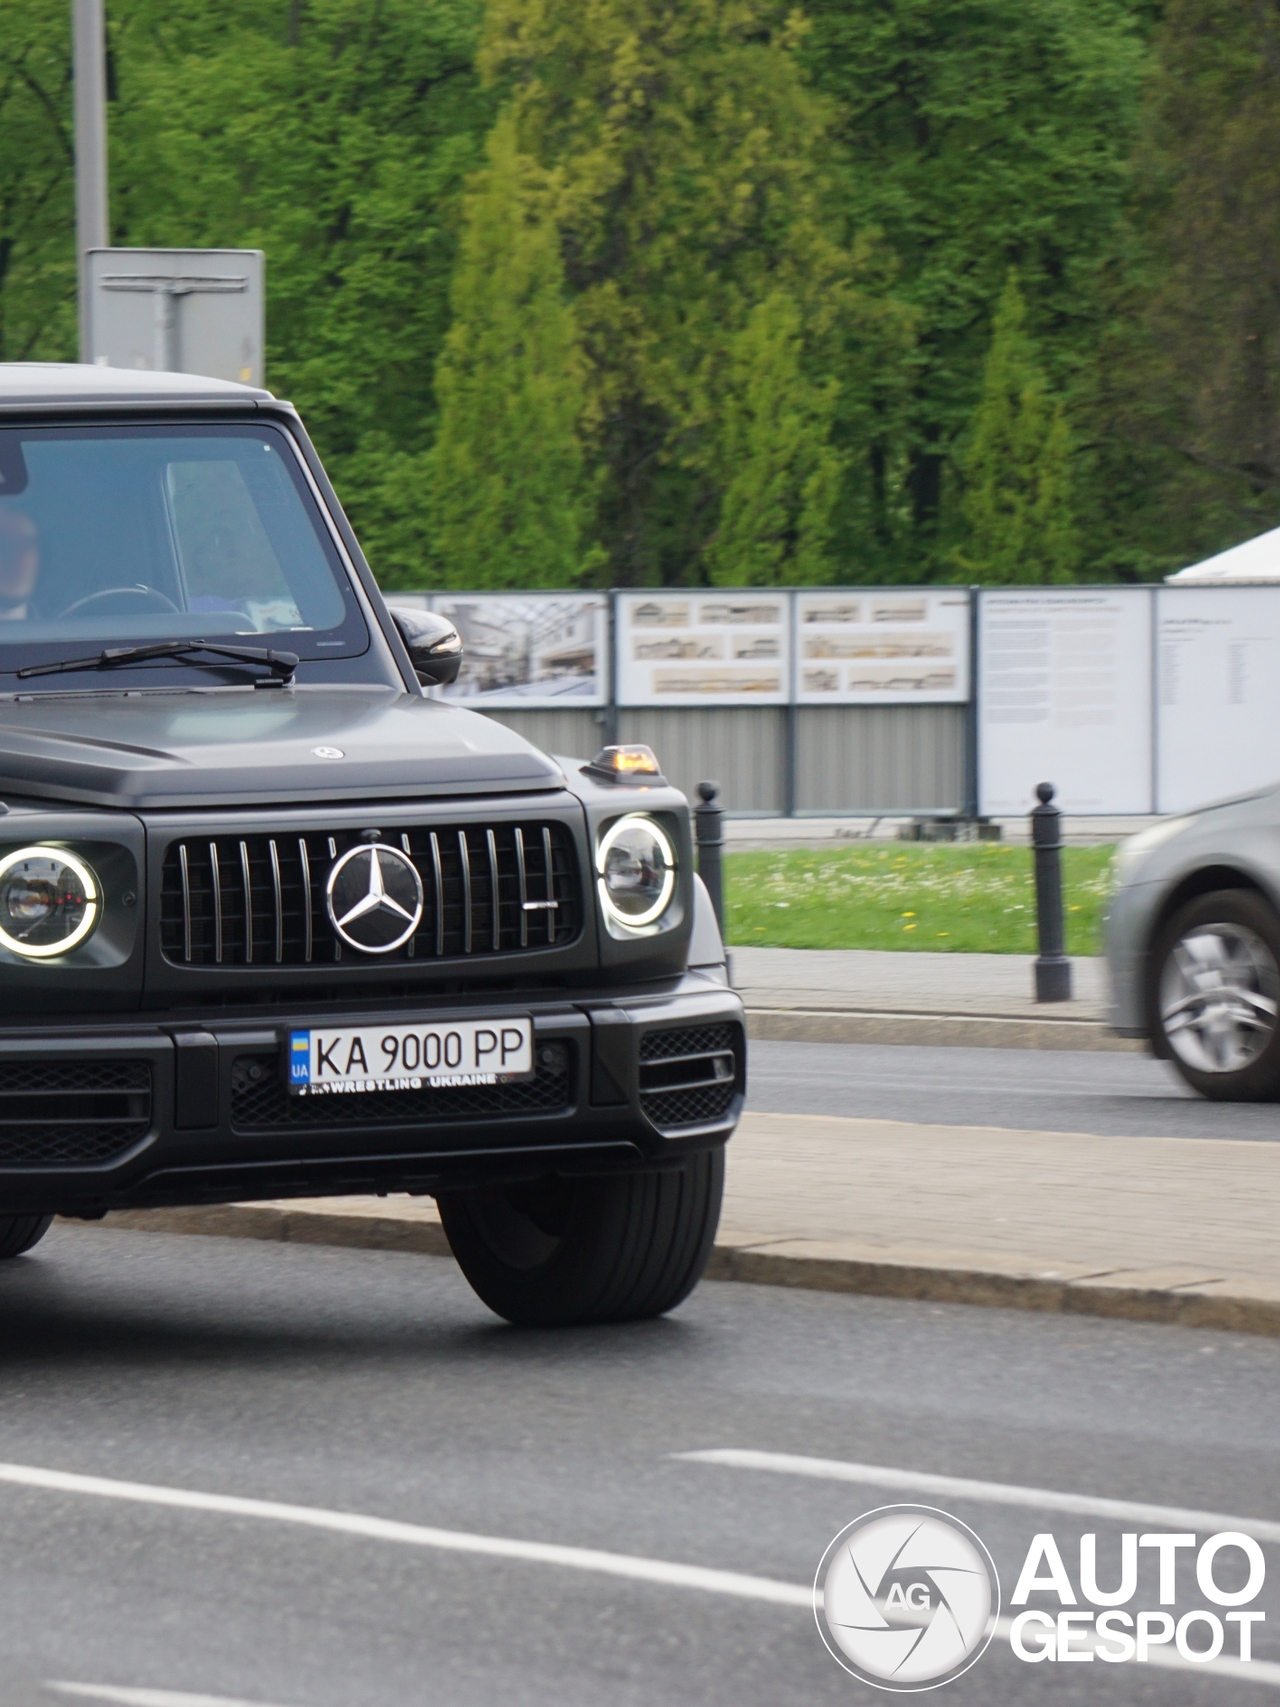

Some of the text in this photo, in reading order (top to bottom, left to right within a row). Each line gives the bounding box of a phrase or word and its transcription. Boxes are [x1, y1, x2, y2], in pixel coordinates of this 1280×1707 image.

[316, 1028, 524, 1077] KA 9000 PP
[291, 1063, 309, 1078] UA
[330, 1073, 496, 1094] WRESTLING UKRAINE
